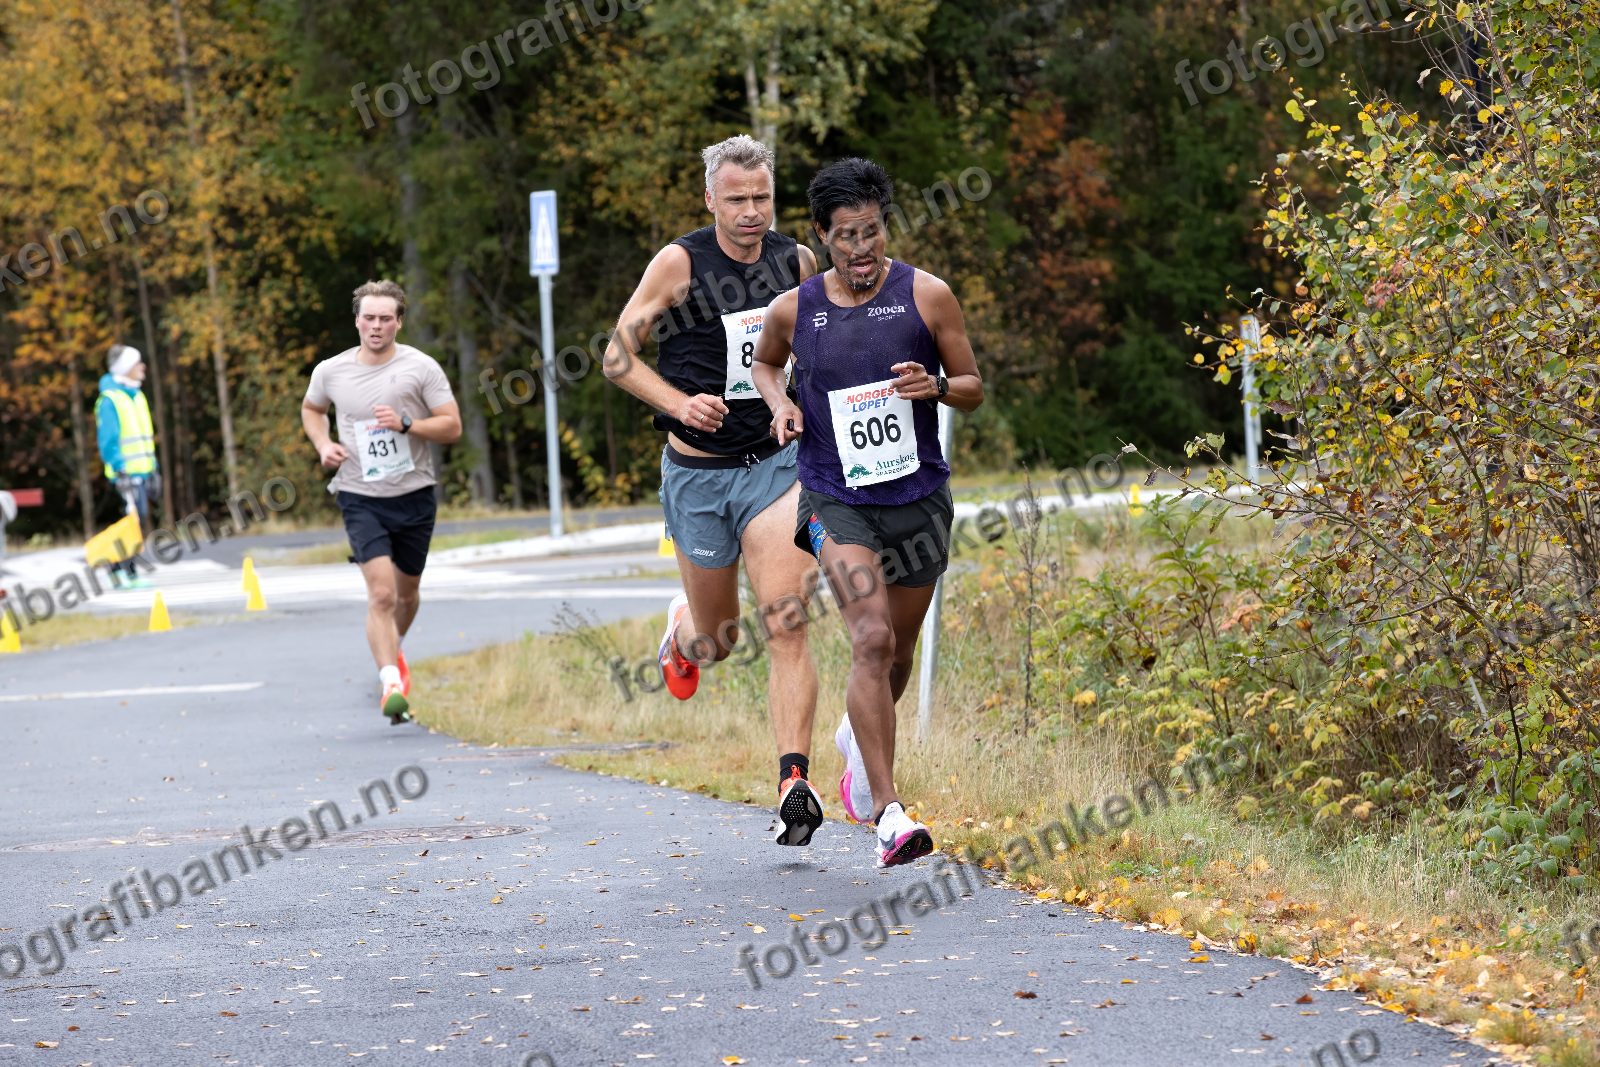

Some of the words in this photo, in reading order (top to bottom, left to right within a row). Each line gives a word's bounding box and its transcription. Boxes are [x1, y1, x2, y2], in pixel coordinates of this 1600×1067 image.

[846, 386, 895, 404] NORGES
[852, 397, 889, 412] LØPET
[850, 413, 902, 450] 606
[368, 437, 398, 458] 431
[875, 452, 916, 470] Aurskog
